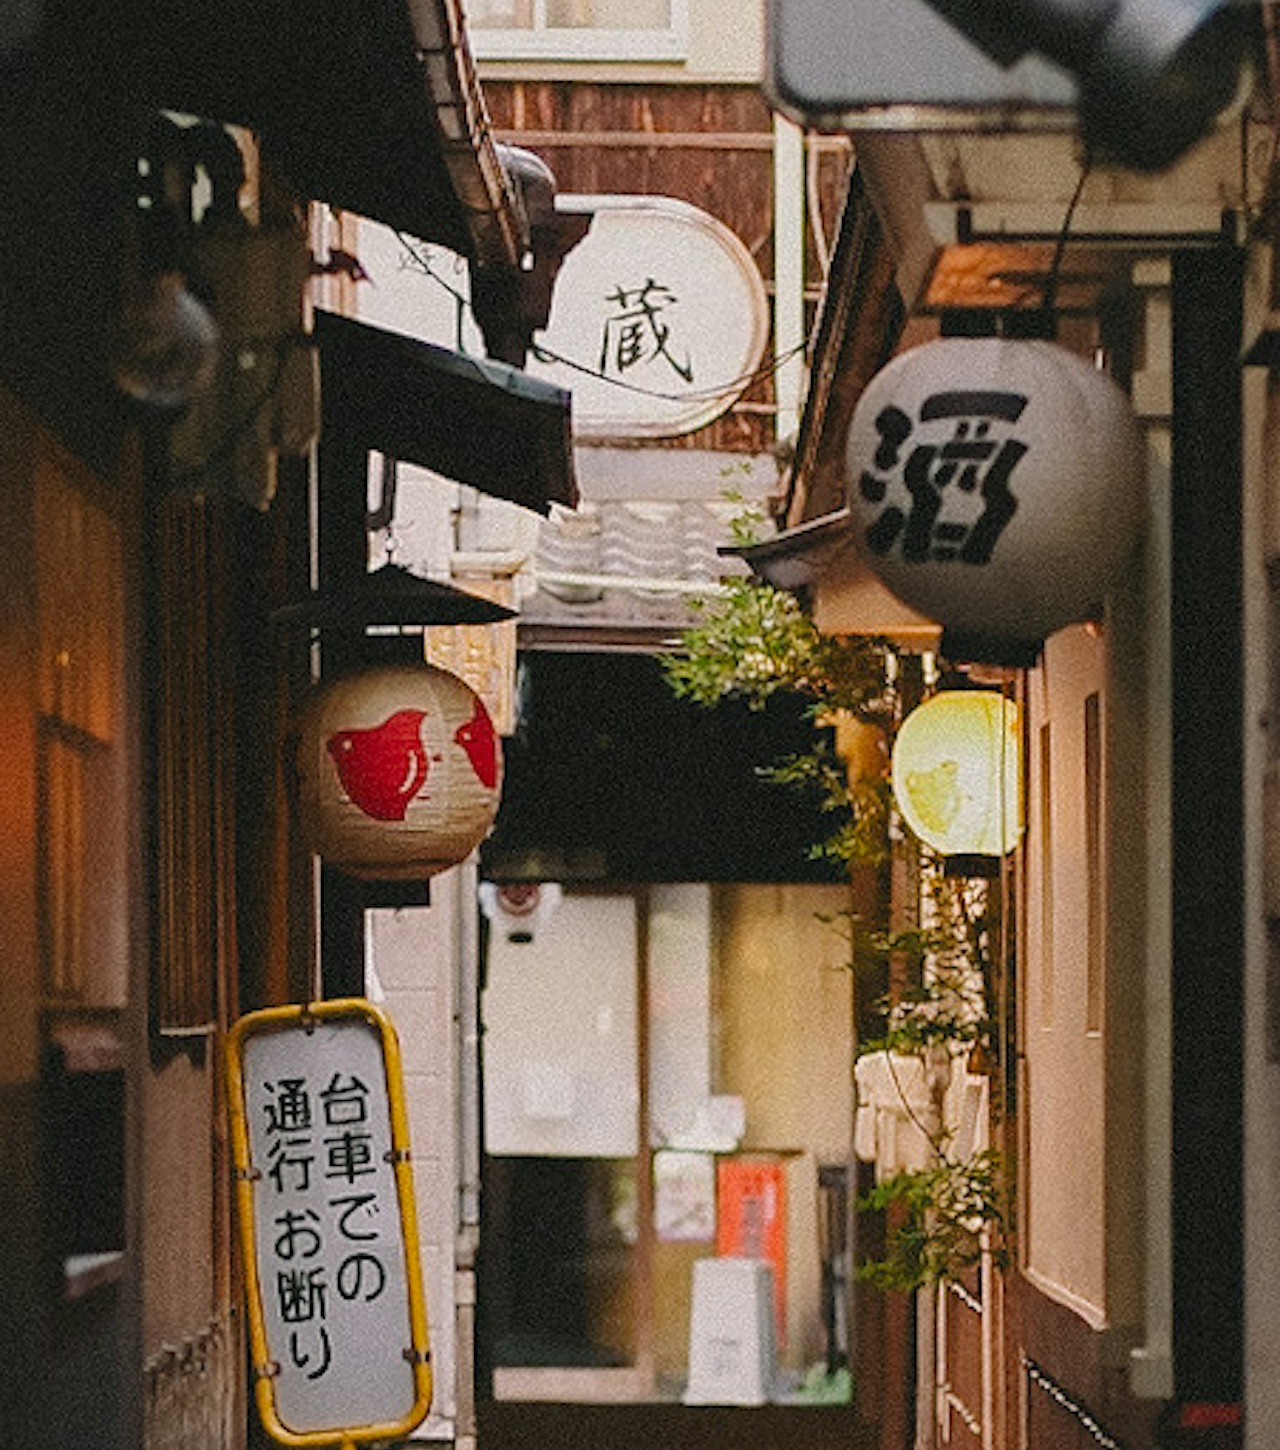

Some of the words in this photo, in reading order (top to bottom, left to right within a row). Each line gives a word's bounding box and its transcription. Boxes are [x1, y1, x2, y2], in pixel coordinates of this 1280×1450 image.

[599, 277, 693, 384] 蔵
[858, 390, 1030, 567] 酒
[261, 1076, 332, 1381] 通行お断り
[319, 1071, 386, 1304] 台車での
